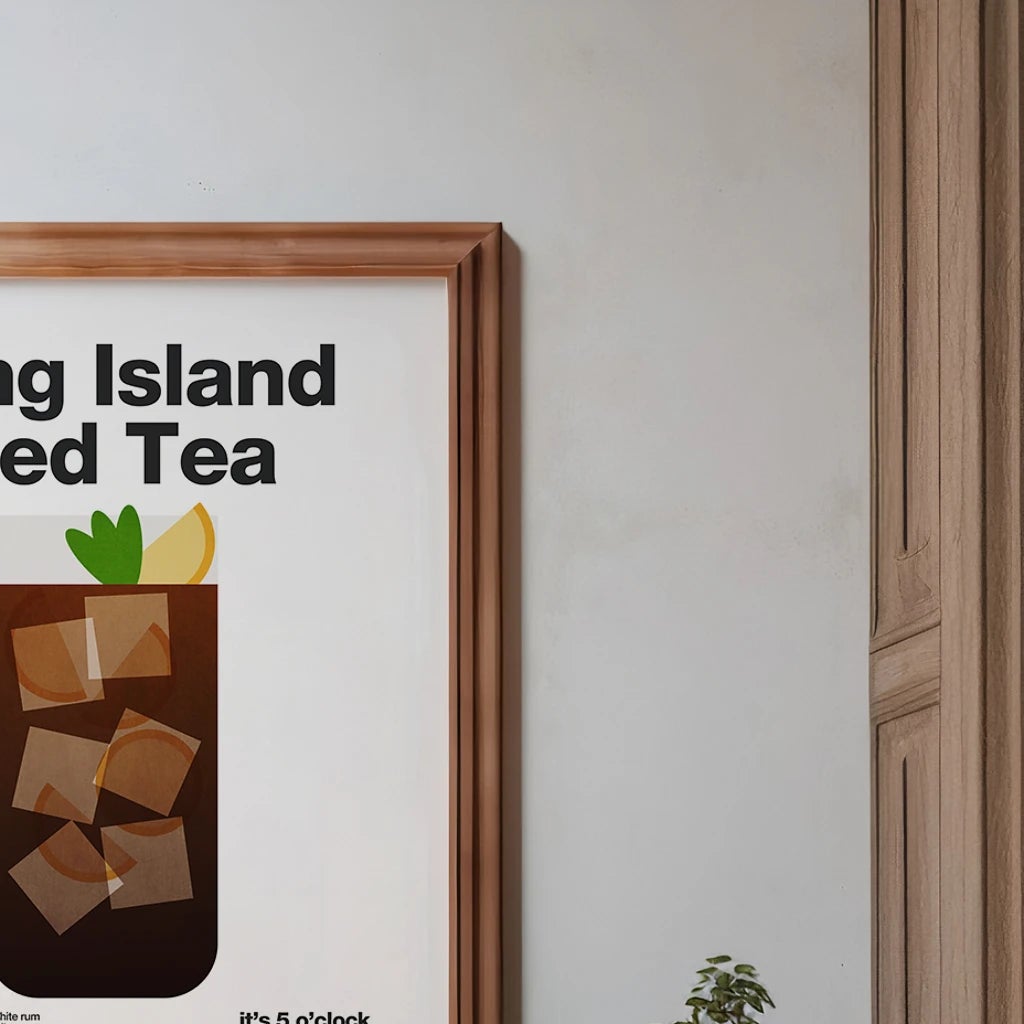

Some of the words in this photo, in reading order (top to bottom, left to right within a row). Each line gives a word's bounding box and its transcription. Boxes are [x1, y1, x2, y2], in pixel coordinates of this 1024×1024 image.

[97, 344, 336, 407] Island
[126, 422, 277, 486] Tea
[20, 1013, 41, 1022] rum
